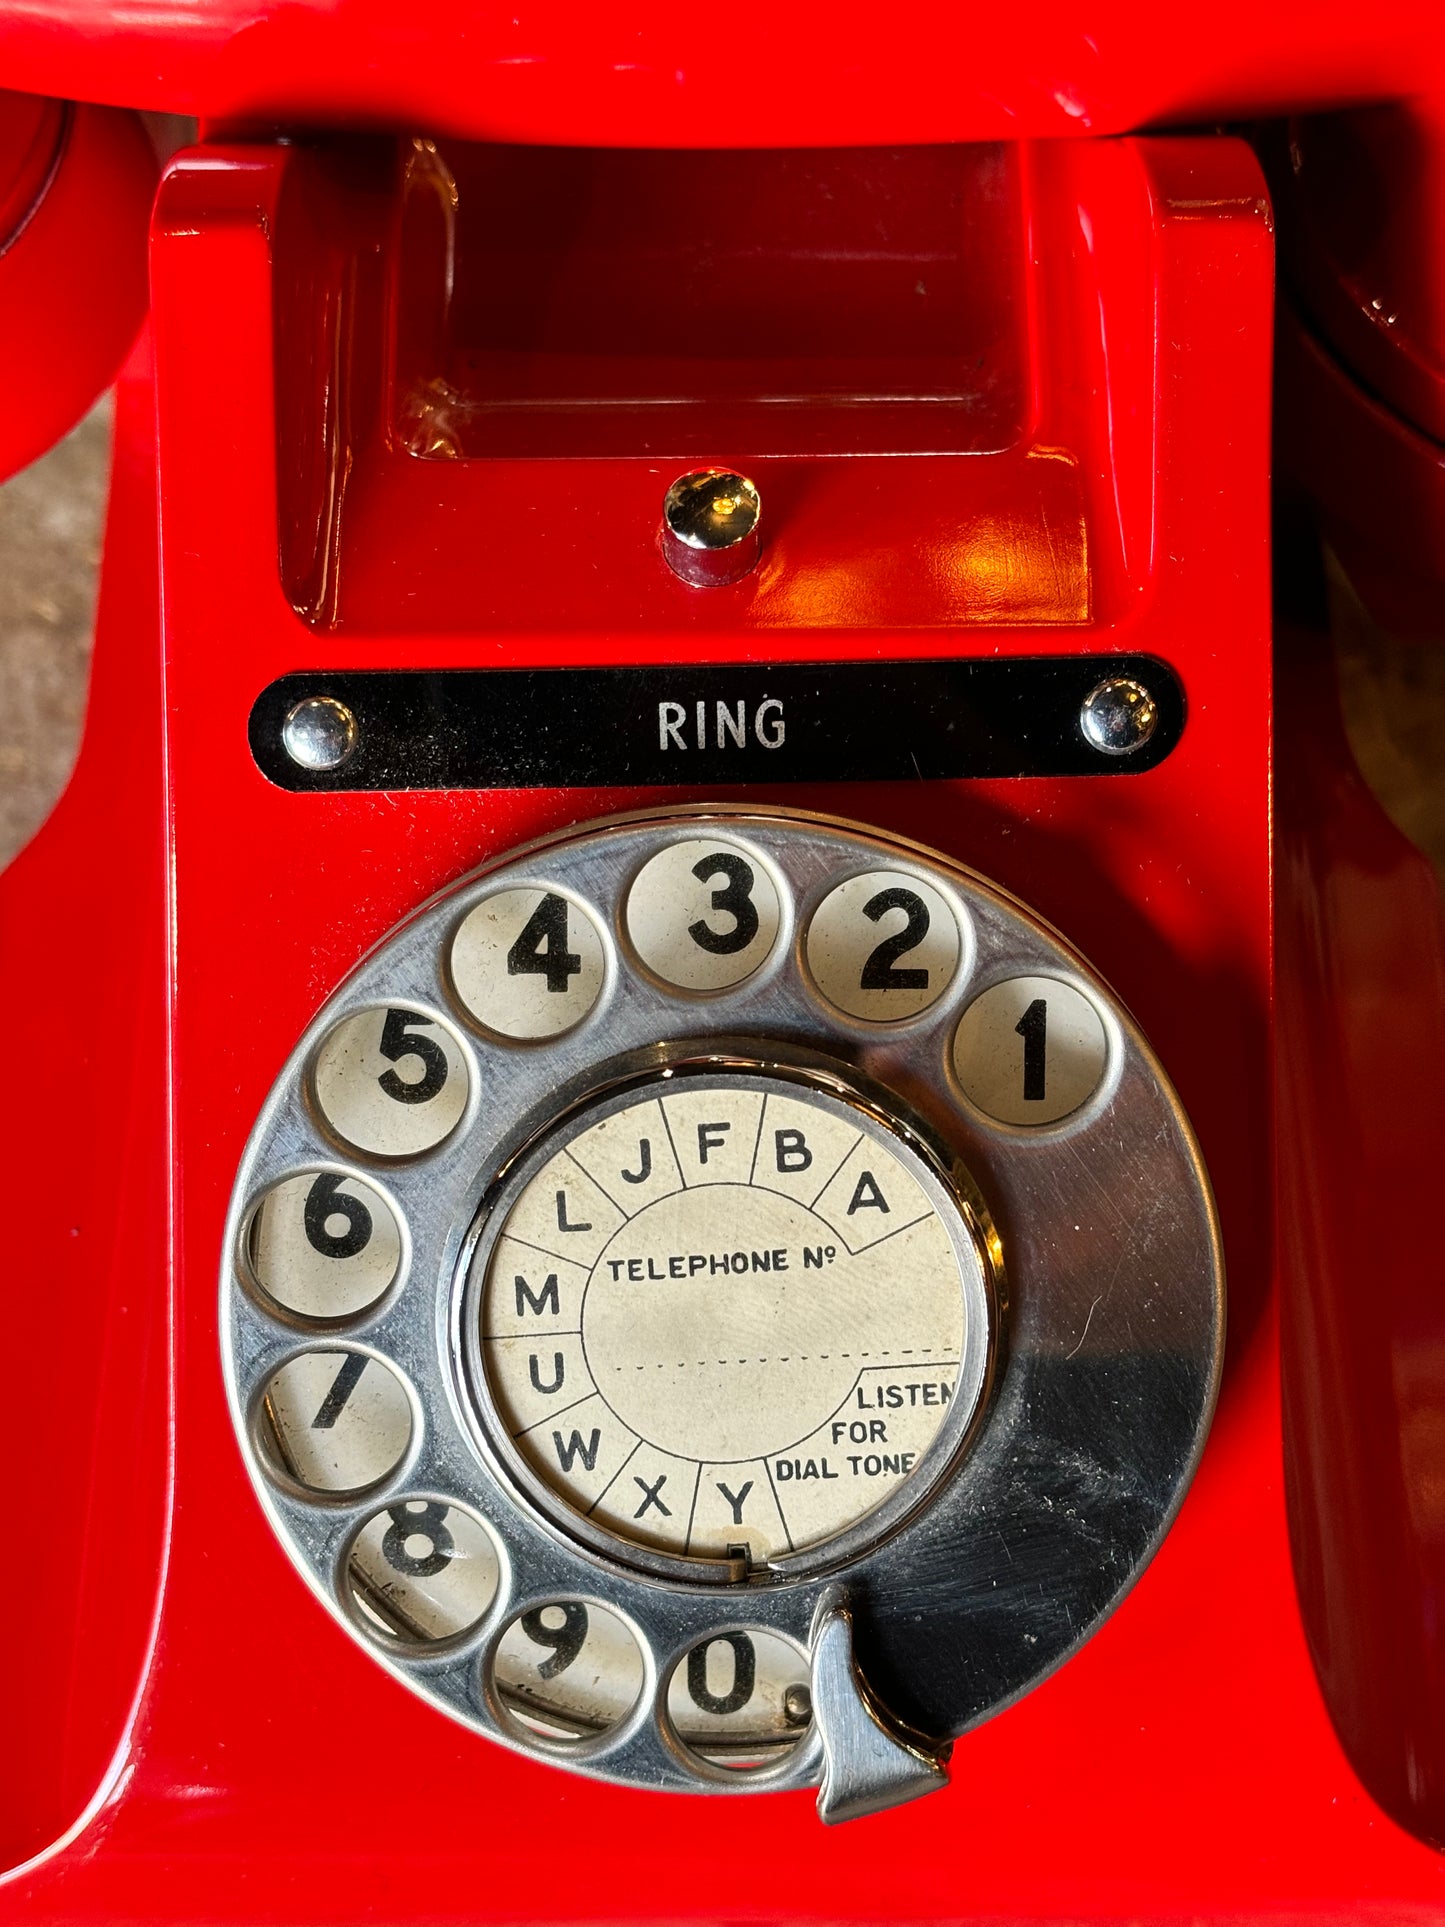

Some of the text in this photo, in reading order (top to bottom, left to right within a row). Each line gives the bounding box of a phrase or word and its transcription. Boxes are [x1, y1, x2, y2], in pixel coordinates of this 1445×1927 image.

[659, 700, 784, 749] RING
[688, 853, 761, 955] 3
[507, 893, 581, 992] 4
[857, 888, 932, 992] 2
[378, 1008, 448, 1104] 5
[1010, 997, 1050, 1104] 1
[622, 1139, 651, 1183] J
[698, 1123, 730, 1164] F
[775, 1129, 812, 1172] B
[304, 1173, 372, 1257] 6
[557, 1191, 592, 1232] L
[847, 1171, 890, 1215] A
[608, 1249, 789, 1281] TELEPHONE
[515, 1274, 559, 1316] M
[309, 1349, 370, 1428] 7
[530, 1353, 564, 1393] U
[858, 1382, 955, 1409] LISTEN
[551, 1429, 600, 1473] W
[832, 1420, 887, 1444] FOR
[777, 1453, 915, 1480] DIAL TONE
[634, 1476, 672, 1518] X
[717, 1482, 753, 1524] Y
[382, 1500, 452, 1577] 8
[521, 1601, 588, 1679] 9
[688, 1630, 755, 1714] 0
